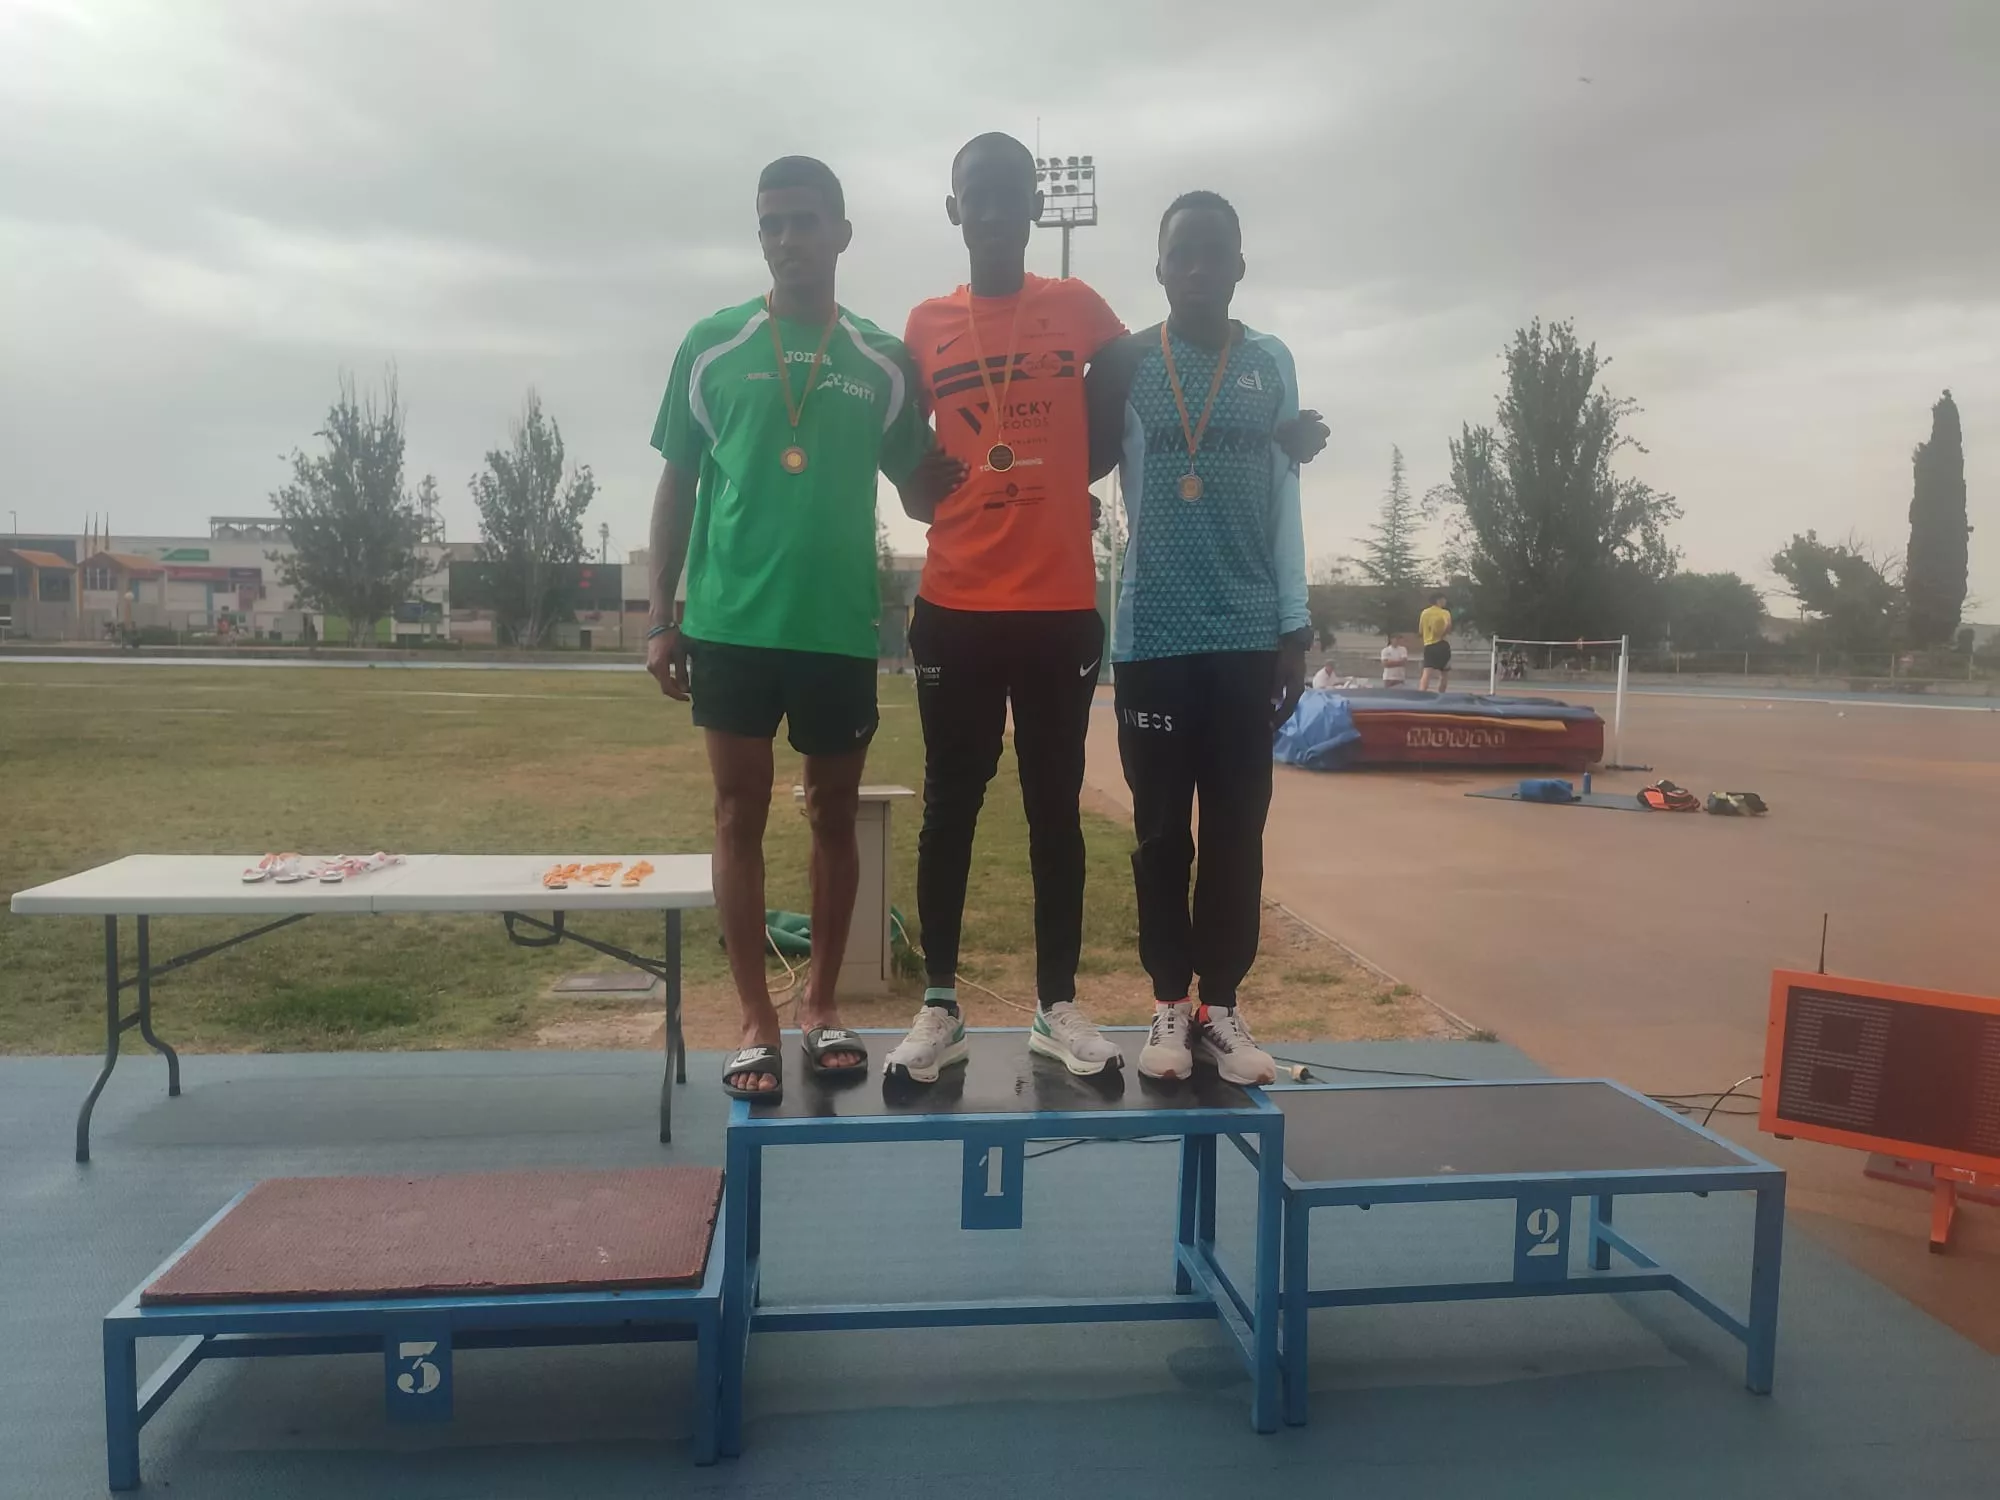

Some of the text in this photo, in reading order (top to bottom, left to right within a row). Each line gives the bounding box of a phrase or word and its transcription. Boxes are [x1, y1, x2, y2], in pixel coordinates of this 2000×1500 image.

[737, 1047, 768, 1061] NIKE
[822, 1029, 848, 1040] NIKE
[979, 1146, 1004, 1197] 1
[1526, 1208, 1560, 1257] 2
[397, 1341, 441, 1394] 3
